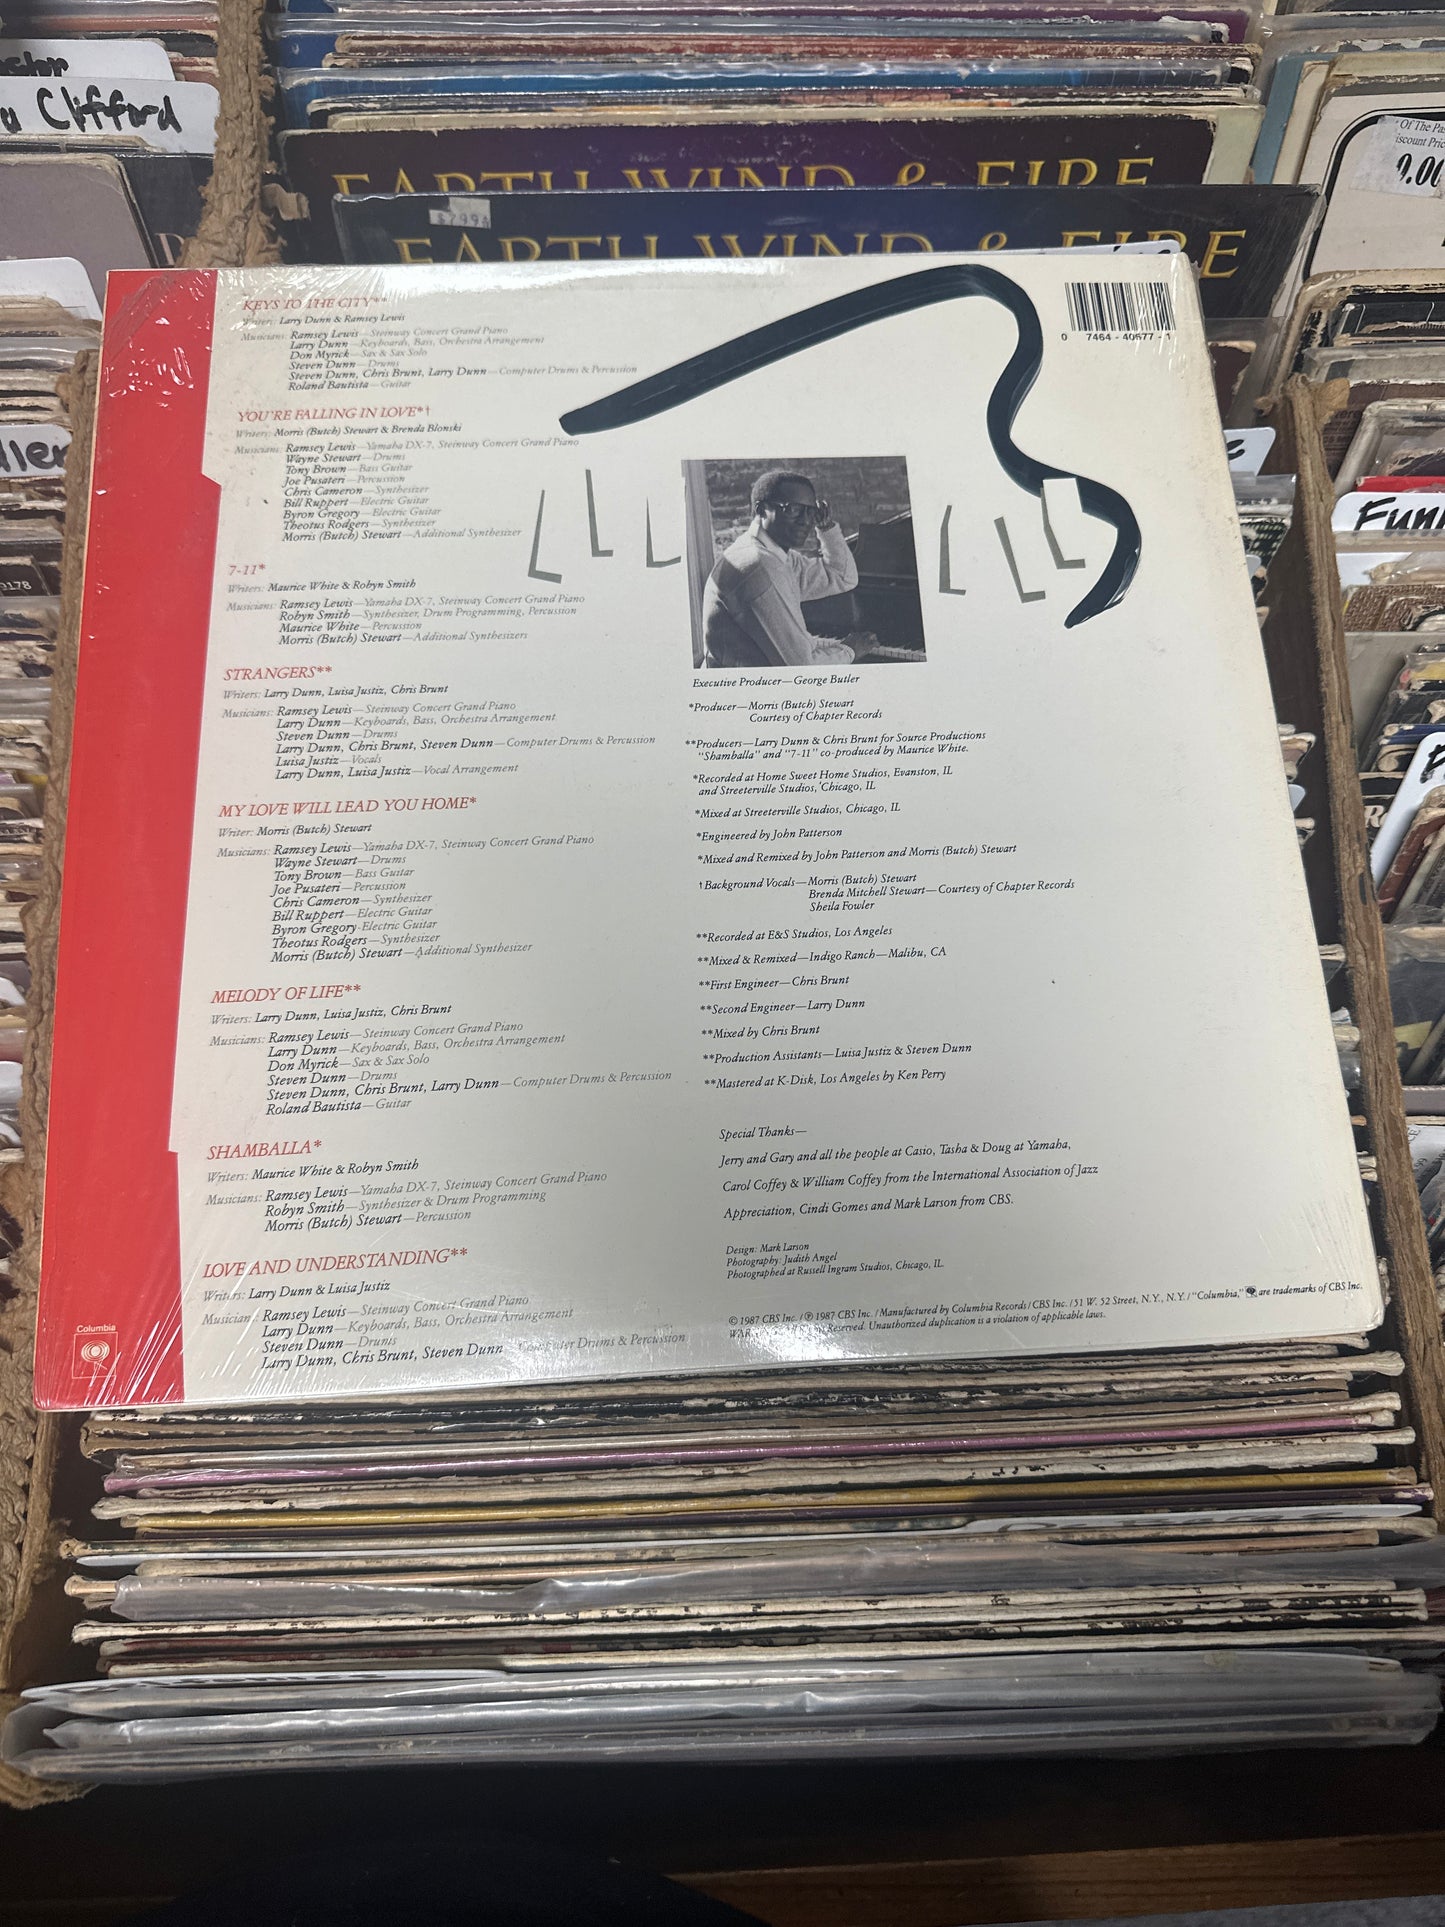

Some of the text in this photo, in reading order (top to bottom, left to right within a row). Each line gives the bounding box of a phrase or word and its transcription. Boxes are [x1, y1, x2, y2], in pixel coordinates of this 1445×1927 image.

[37, 85, 183, 133] Clifford
[1061, 333, 1068, 341] 0
[1086, 333, 1112, 341] 7464
[238, 409, 292, 422] YOU'RE
[294, 407, 357, 420] FALLING
[359, 407, 378, 418] IN
[273, 427, 304, 437] Morris
[305, 425, 341, 437] (Butch)
[342, 425, 379, 435] Stewart
[380, 425, 389, 434] &
[391, 423, 425, 433] Brenda
[426, 423, 462, 432] Blonski
[1352, 497, 1445, 537] Fun
[277, 634, 314, 645] Morris
[316, 632, 358, 646] (Butch)
[468, 630, 528, 642] Synthesizers
[692, 678, 737, 688] Executive
[829, 673, 860, 684] Butler
[749, 708, 882, 724] Courtesy of Chapter Records
[762, 748, 783, 759] and
[819, 745, 882, 759] co-produced
[882, 744, 895, 757] by
[896, 744, 935, 754] Maurice
[937, 742, 968, 753] White.
[744, 774, 754, 782] at
[756, 771, 787, 781] Home
[788, 770, 817, 780] Sweet
[818, 769, 850, 779] Home
[851, 767, 890, 778] Studios,
[893, 767, 939, 777] Evanston,
[942, 765, 953, 775] IL
[698, 780, 876, 796] and Streeterville Studios, Chicago, IL
[218, 804, 247, 818] MY
[247, 802, 289, 816] LOVE
[293, 801, 332, 815] WILL
[334, 799, 379, 813] LEAD
[383, 798, 419, 811] YOU
[758, 829, 771, 842] by
[770, 828, 796, 841] John
[798, 828, 842, 838] Patterson
[809, 899, 875, 912] Sheila Fowler
[755, 932, 765, 940] at
[767, 929, 790, 940] E&S
[791, 927, 831, 939] Studios,
[834, 927, 851, 937] Los
[853, 924, 892, 938] Angeles
[210, 987, 282, 1004] MELODY
[284, 986, 308, 1000] OF
[764, 1078, 774, 1086] at
[776, 1073, 816, 1085] K-Disk,
[820, 1073, 837, 1084] Los
[839, 1070, 880, 1085] Angeles
[882, 1069, 895, 1083] by
[897, 1069, 918, 1080] Ken
[921, 1068, 946, 1081] Perry
[719, 1126, 756, 1142] Special
[718, 1138, 1071, 1168] Jerry and Gary and all the people at Casio, Tasha & Doug at Yamaha,
[250, 1166, 296, 1180] Maurice
[298, 1164, 333, 1177] White
[334, 1164, 345, 1175] &
[347, 1161, 383, 1176] Robyn
[385, 1157, 419, 1172] Smith
[725, 1242, 809, 1256] Design: Mark Larson
[726, 1251, 838, 1268] Photography: Judith Angel
[202, 1261, 247, 1278] LOVE
[247, 1258, 291, 1276] AND
[727, 1258, 944, 1280] Photographed at Russell Ingram Studios, Chicago, IL
[740, 1315, 760, 1326] 1987
[760, 1313, 781, 1326] CBS
[781, 1313, 798, 1323] Inc.
[815, 1310, 836, 1321] 1987
[837, 1309, 856, 1319] CBS
[857, 1308, 873, 1318] Inc.
[879, 1304, 939, 1318] Manufactured
[939, 1304, 950, 1316] by
[951, 1302, 993, 1313] Columbia
[994, 1299, 1026, 1311] Records
[1032, 1299, 1050, 1309] CBS
[1052, 1298, 1068, 1308] Inc.
[1073, 1298, 1083, 1308] 51
[1086, 1296, 1097, 1306] W.
[1100, 1296, 1111, 1306] 52
[1111, 1295, 1139, 1305] Street,
[1140, 1293, 1163, 1303] N.Y.,
[1166, 1291, 1185, 1302] N.Y.
[1272, 1283, 1316, 1295] trademarks
[1317, 1282, 1328, 1294] of
[1327, 1281, 1346, 1292] CBS
[1347, 1280, 1363, 1290] Inc.
[77, 1324, 116, 1333] Columbia
